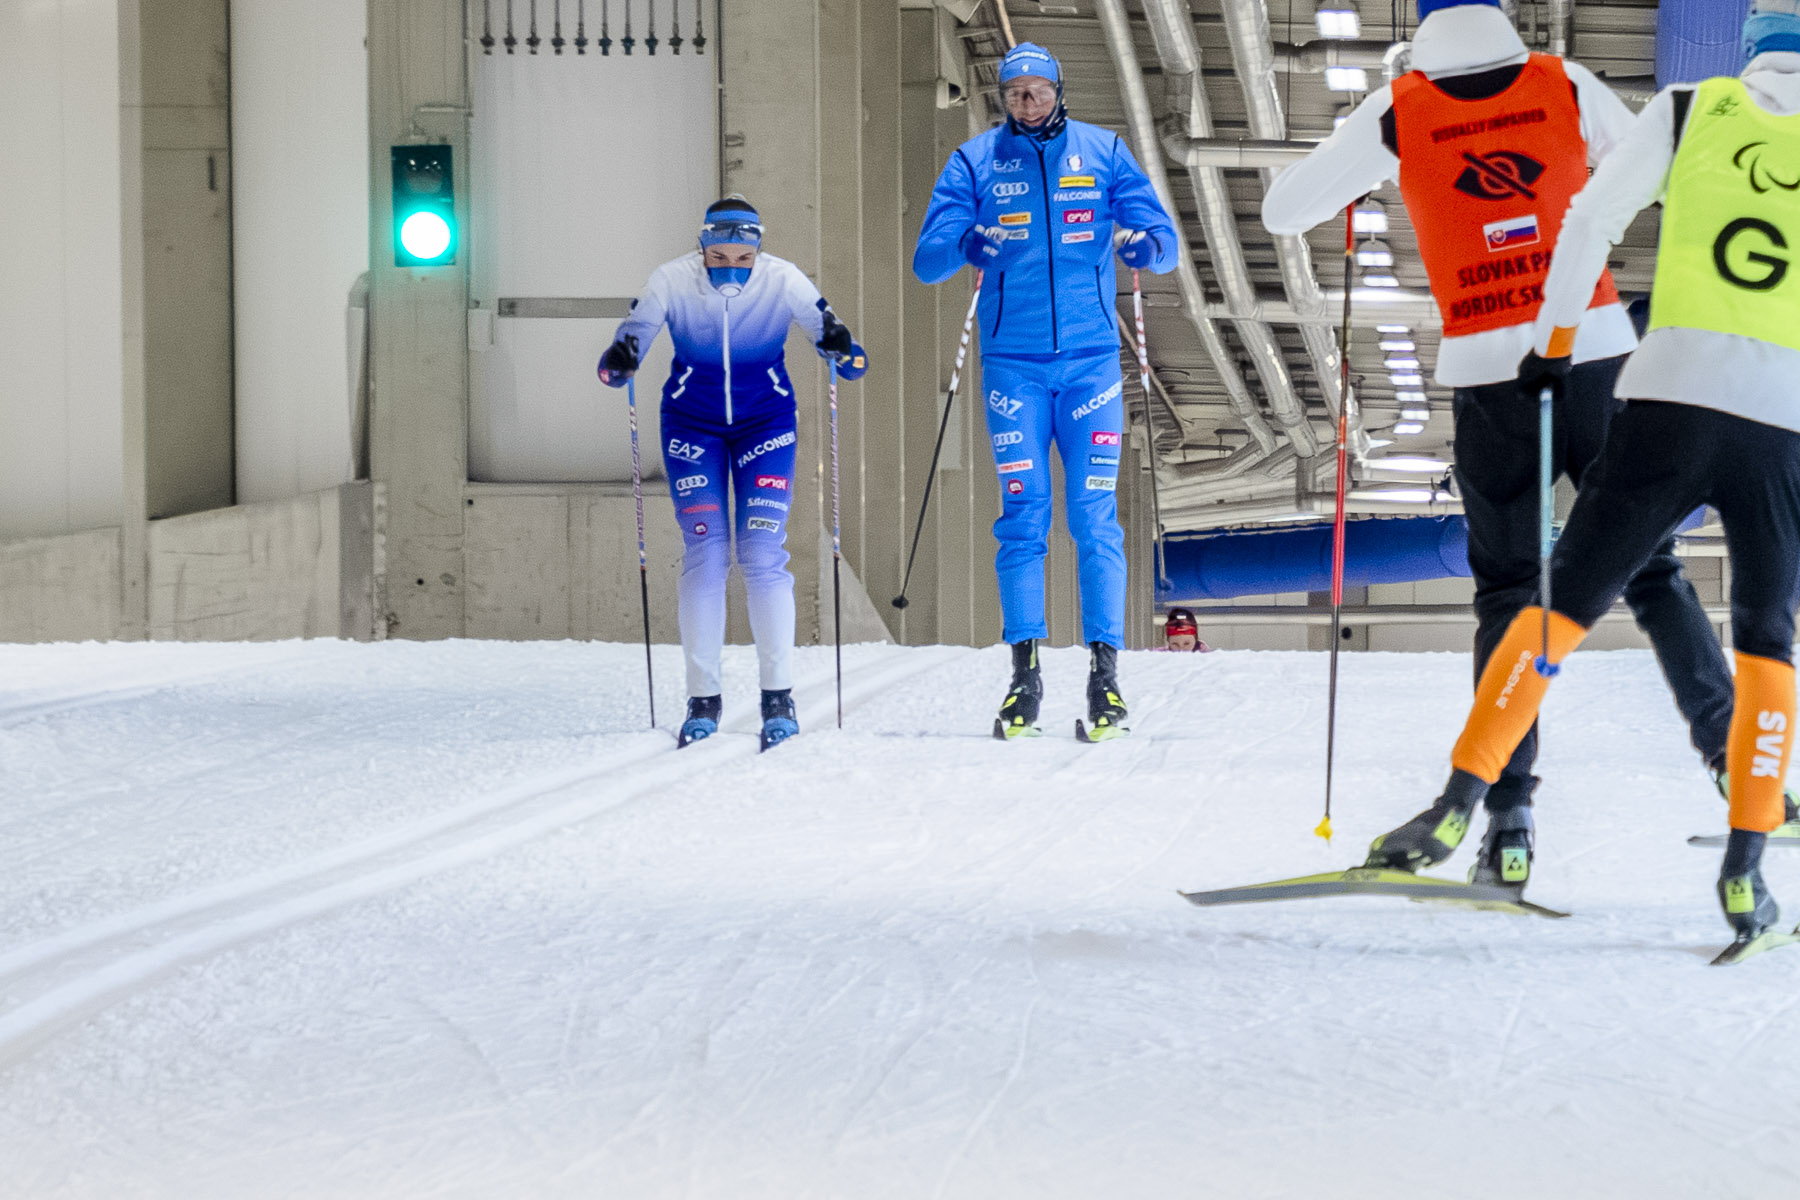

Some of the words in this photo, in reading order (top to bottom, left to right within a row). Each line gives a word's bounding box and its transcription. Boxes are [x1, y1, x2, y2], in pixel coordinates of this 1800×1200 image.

[1712, 216, 1789, 292] G
[1457, 254, 1530, 288] SLOVAK
[1451, 289, 1517, 319] NORDIC
[989, 389, 1023, 416] EA7
[668, 438, 705, 460] EA7
[1751, 710, 1787, 779] SVK
